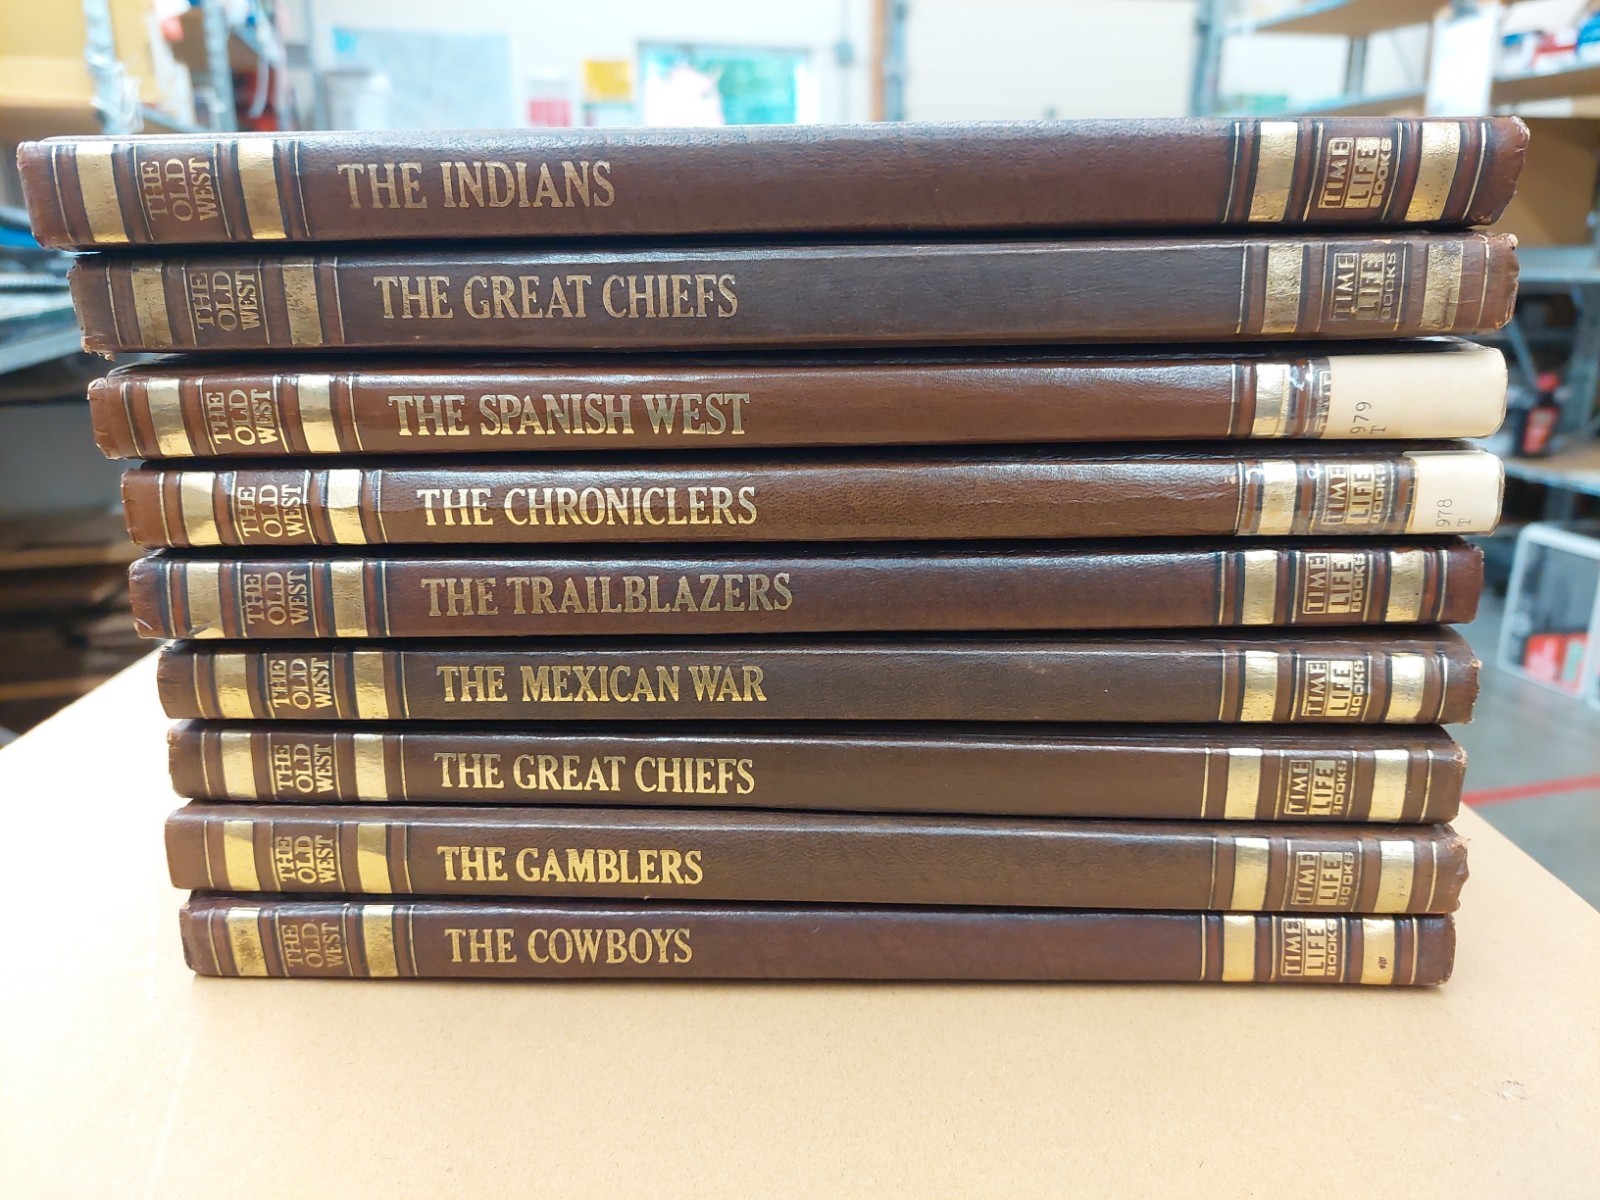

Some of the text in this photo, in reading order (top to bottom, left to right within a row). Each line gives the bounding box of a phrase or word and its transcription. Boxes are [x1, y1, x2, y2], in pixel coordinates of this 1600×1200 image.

[141, 161, 167, 220] THE
[165, 159, 192, 221] OLD
[189, 158, 219, 221] WEST
[337, 160, 616, 209] THE INDIANS
[1319, 137, 1353, 208] TIME
[1346, 137, 1379, 208] LIFE
[190, 273, 214, 330] THE
[210, 270, 236, 331] OLD
[231, 271, 259, 330] WEST
[373, 274, 738, 319] THE GREAT CHIEFS
[1330, 253, 1357, 320] TIME
[1357, 253, 1384, 321] LIFE
[206, 392, 232, 444] THE
[229, 390, 256, 446] OLD
[252, 389, 280, 444] WEST
[388, 392, 749, 436] THE SPANISH WEST
[1350, 401, 1372, 434] 979
[1370, 426, 1385, 434] T
[235, 486, 259, 537] THE
[259, 483, 282, 538] OLD
[281, 484, 307, 537] WEST
[417, 486, 758, 526] THE CHRONICLERS
[1323, 465, 1348, 524] TIME
[1346, 464, 1374, 524] LIFE
[1436, 498, 1452, 527] 978
[244, 574, 265, 625] THE
[265, 571, 285, 626] OLD
[287, 571, 310, 625] WEST
[421, 572, 792, 617] THE TRAILBLAZERS
[1303, 554, 1326, 613] TIME
[1327, 553, 1352, 613] LIFE
[268, 660, 290, 709] THE
[290, 658, 311, 710] OLD
[310, 658, 334, 709] WEST
[436, 666, 767, 703] THE MEXICAN WAR
[1302, 660, 1327, 717] TIME
[1325, 660, 1351, 717] LIFE
[274, 745, 294, 791] THE
[294, 743, 315, 793] OLD
[313, 745, 336, 793] WEST
[434, 752, 755, 795] THE GREAT CHIEFS
[1285, 760, 1311, 815] TIME
[1309, 760, 1335, 815] LIFE
[276, 837, 296, 883] THE
[296, 835, 316, 884] OLD
[315, 836, 337, 882] WEST
[437, 846, 703, 885] THE GAMBLERS
[1293, 852, 1318, 905] TIME
[1317, 852, 1342, 905] LIFE
[282, 925, 303, 968] THE
[303, 919, 324, 969] OLD
[323, 923, 346, 967] WEST
[444, 928, 693, 964] THE COWBOYS
[1282, 919, 1304, 976] TIME
[1302, 919, 1326, 976] LIFE
